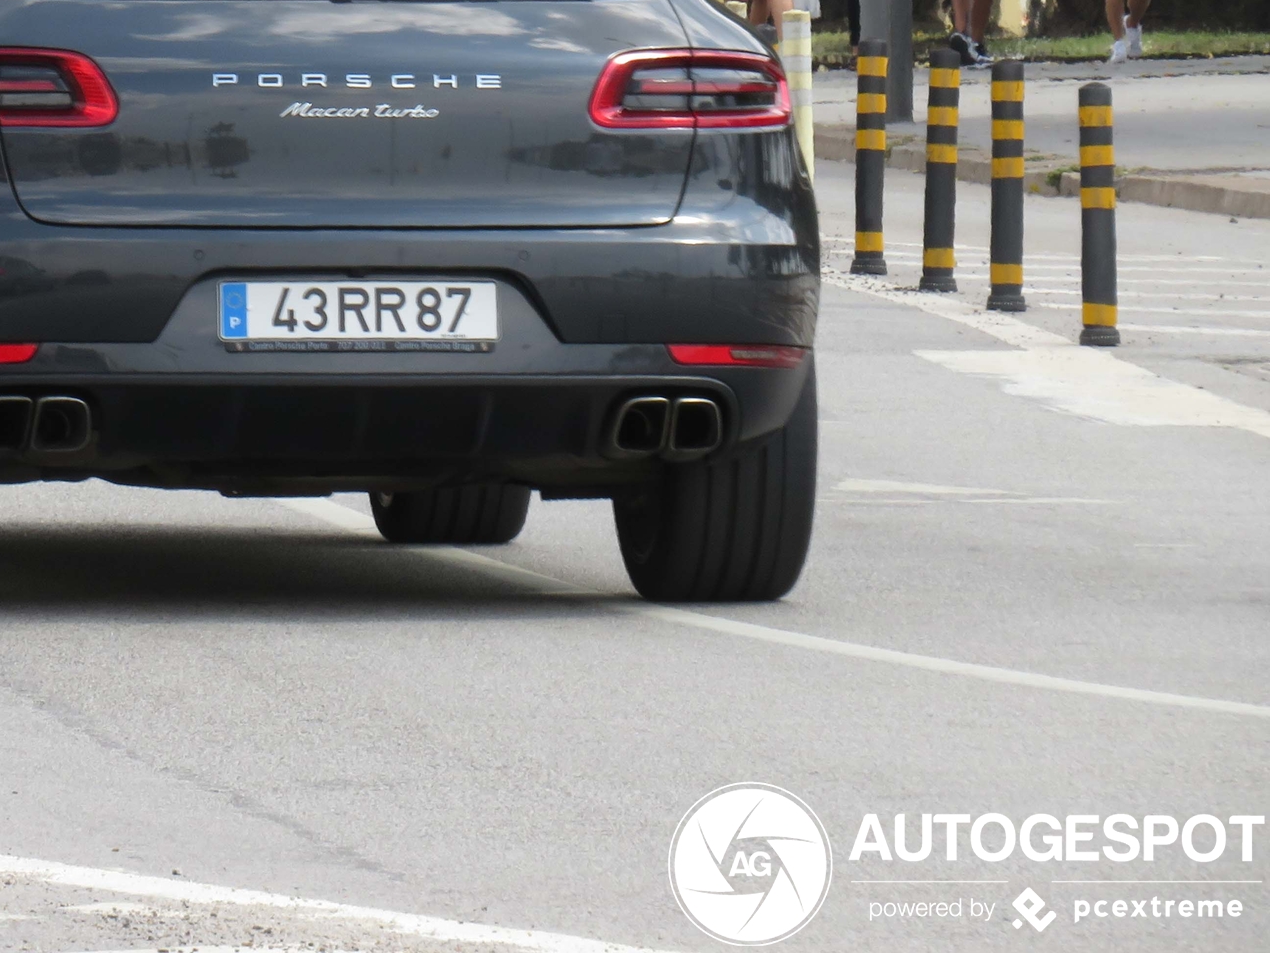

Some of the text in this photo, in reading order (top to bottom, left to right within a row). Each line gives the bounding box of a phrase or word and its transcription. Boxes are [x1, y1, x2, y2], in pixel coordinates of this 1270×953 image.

[212, 73, 503, 89] PORSCHE
[279, 102, 440, 118] Macan turbo
